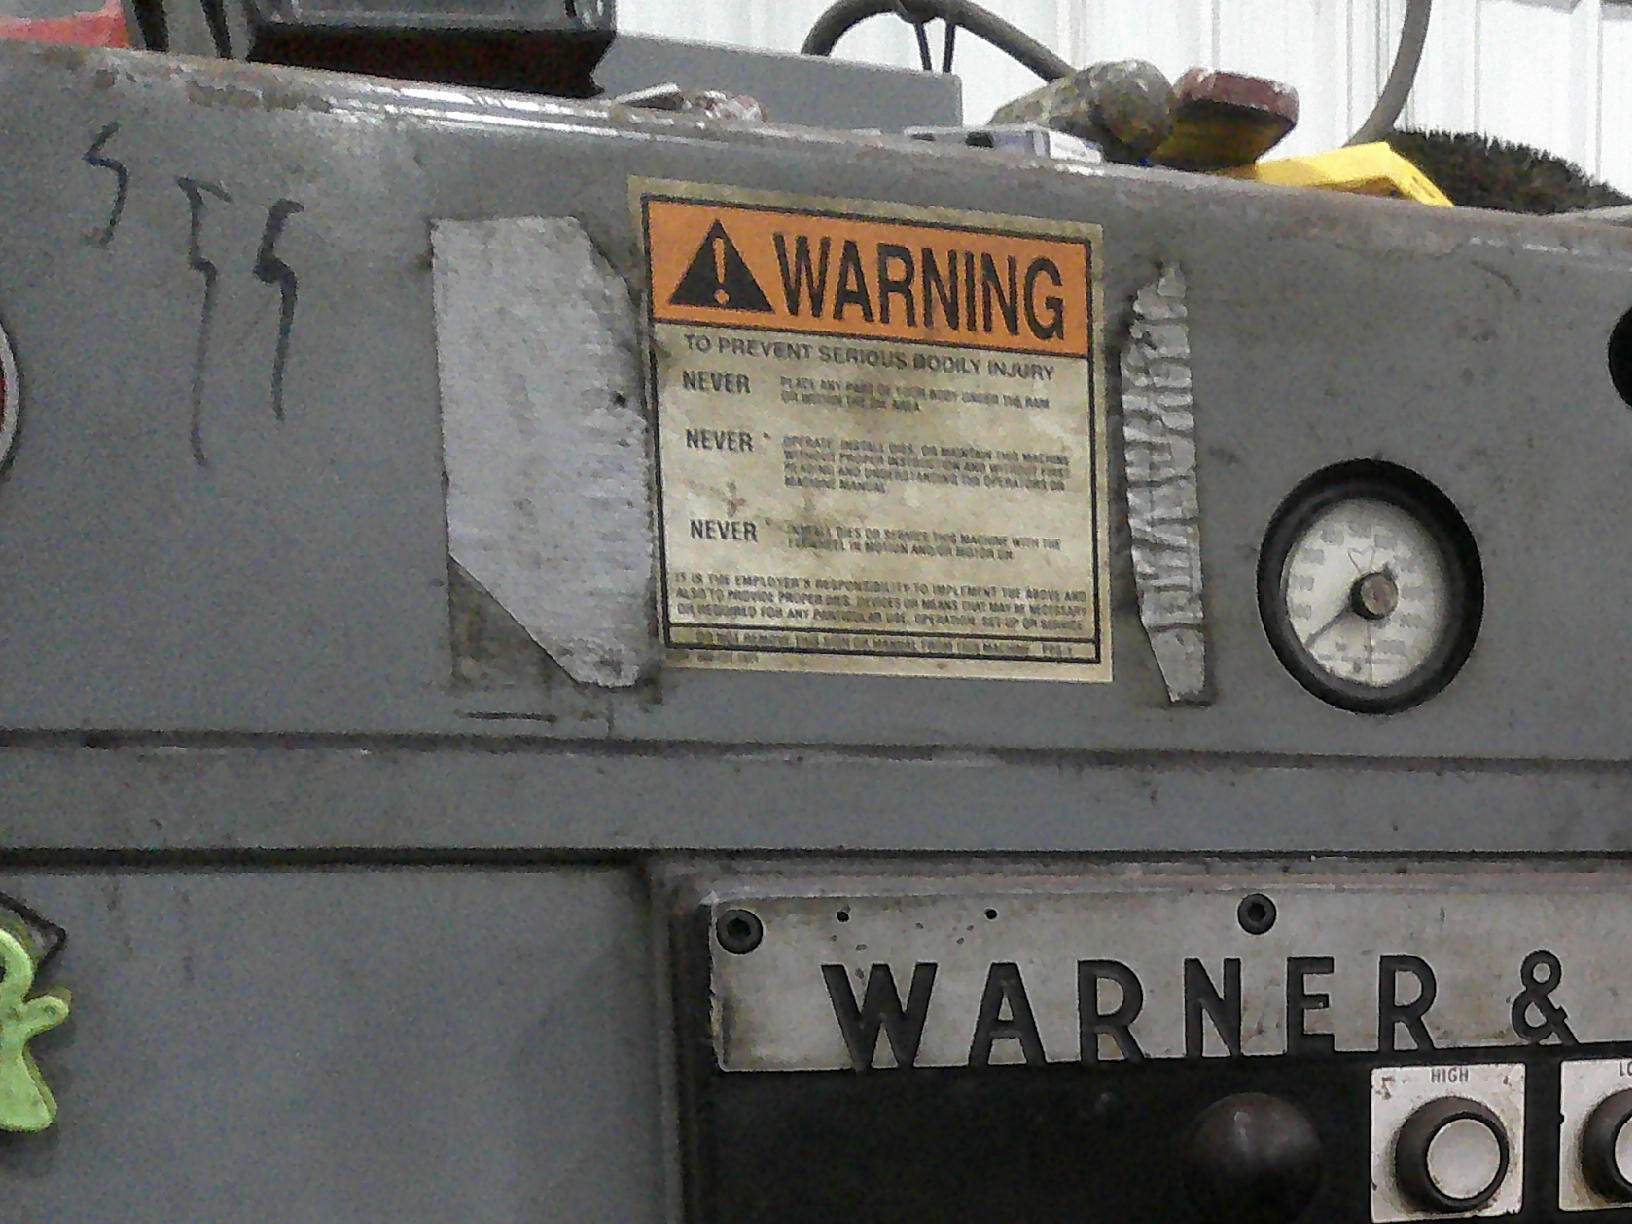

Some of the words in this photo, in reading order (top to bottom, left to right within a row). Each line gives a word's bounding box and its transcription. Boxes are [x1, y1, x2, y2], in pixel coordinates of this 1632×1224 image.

[772, 231, 1065, 340] WARNING
[684, 333, 710, 353] TO
[718, 336, 812, 361] PREVENT
[818, 345, 908, 371] SERIOUS
[913, 353, 981, 374] BODILY
[987, 360, 1054, 381] INJURY
[682, 370, 751, 394] NEVER
[686, 428, 754, 453] NEVER
[690, 519, 759, 542] NEVER
[820, 955, 1438, 1072] WARNER
[1510, 949, 1581, 1046] &
[1431, 1067, 1469, 1083] HIGH
